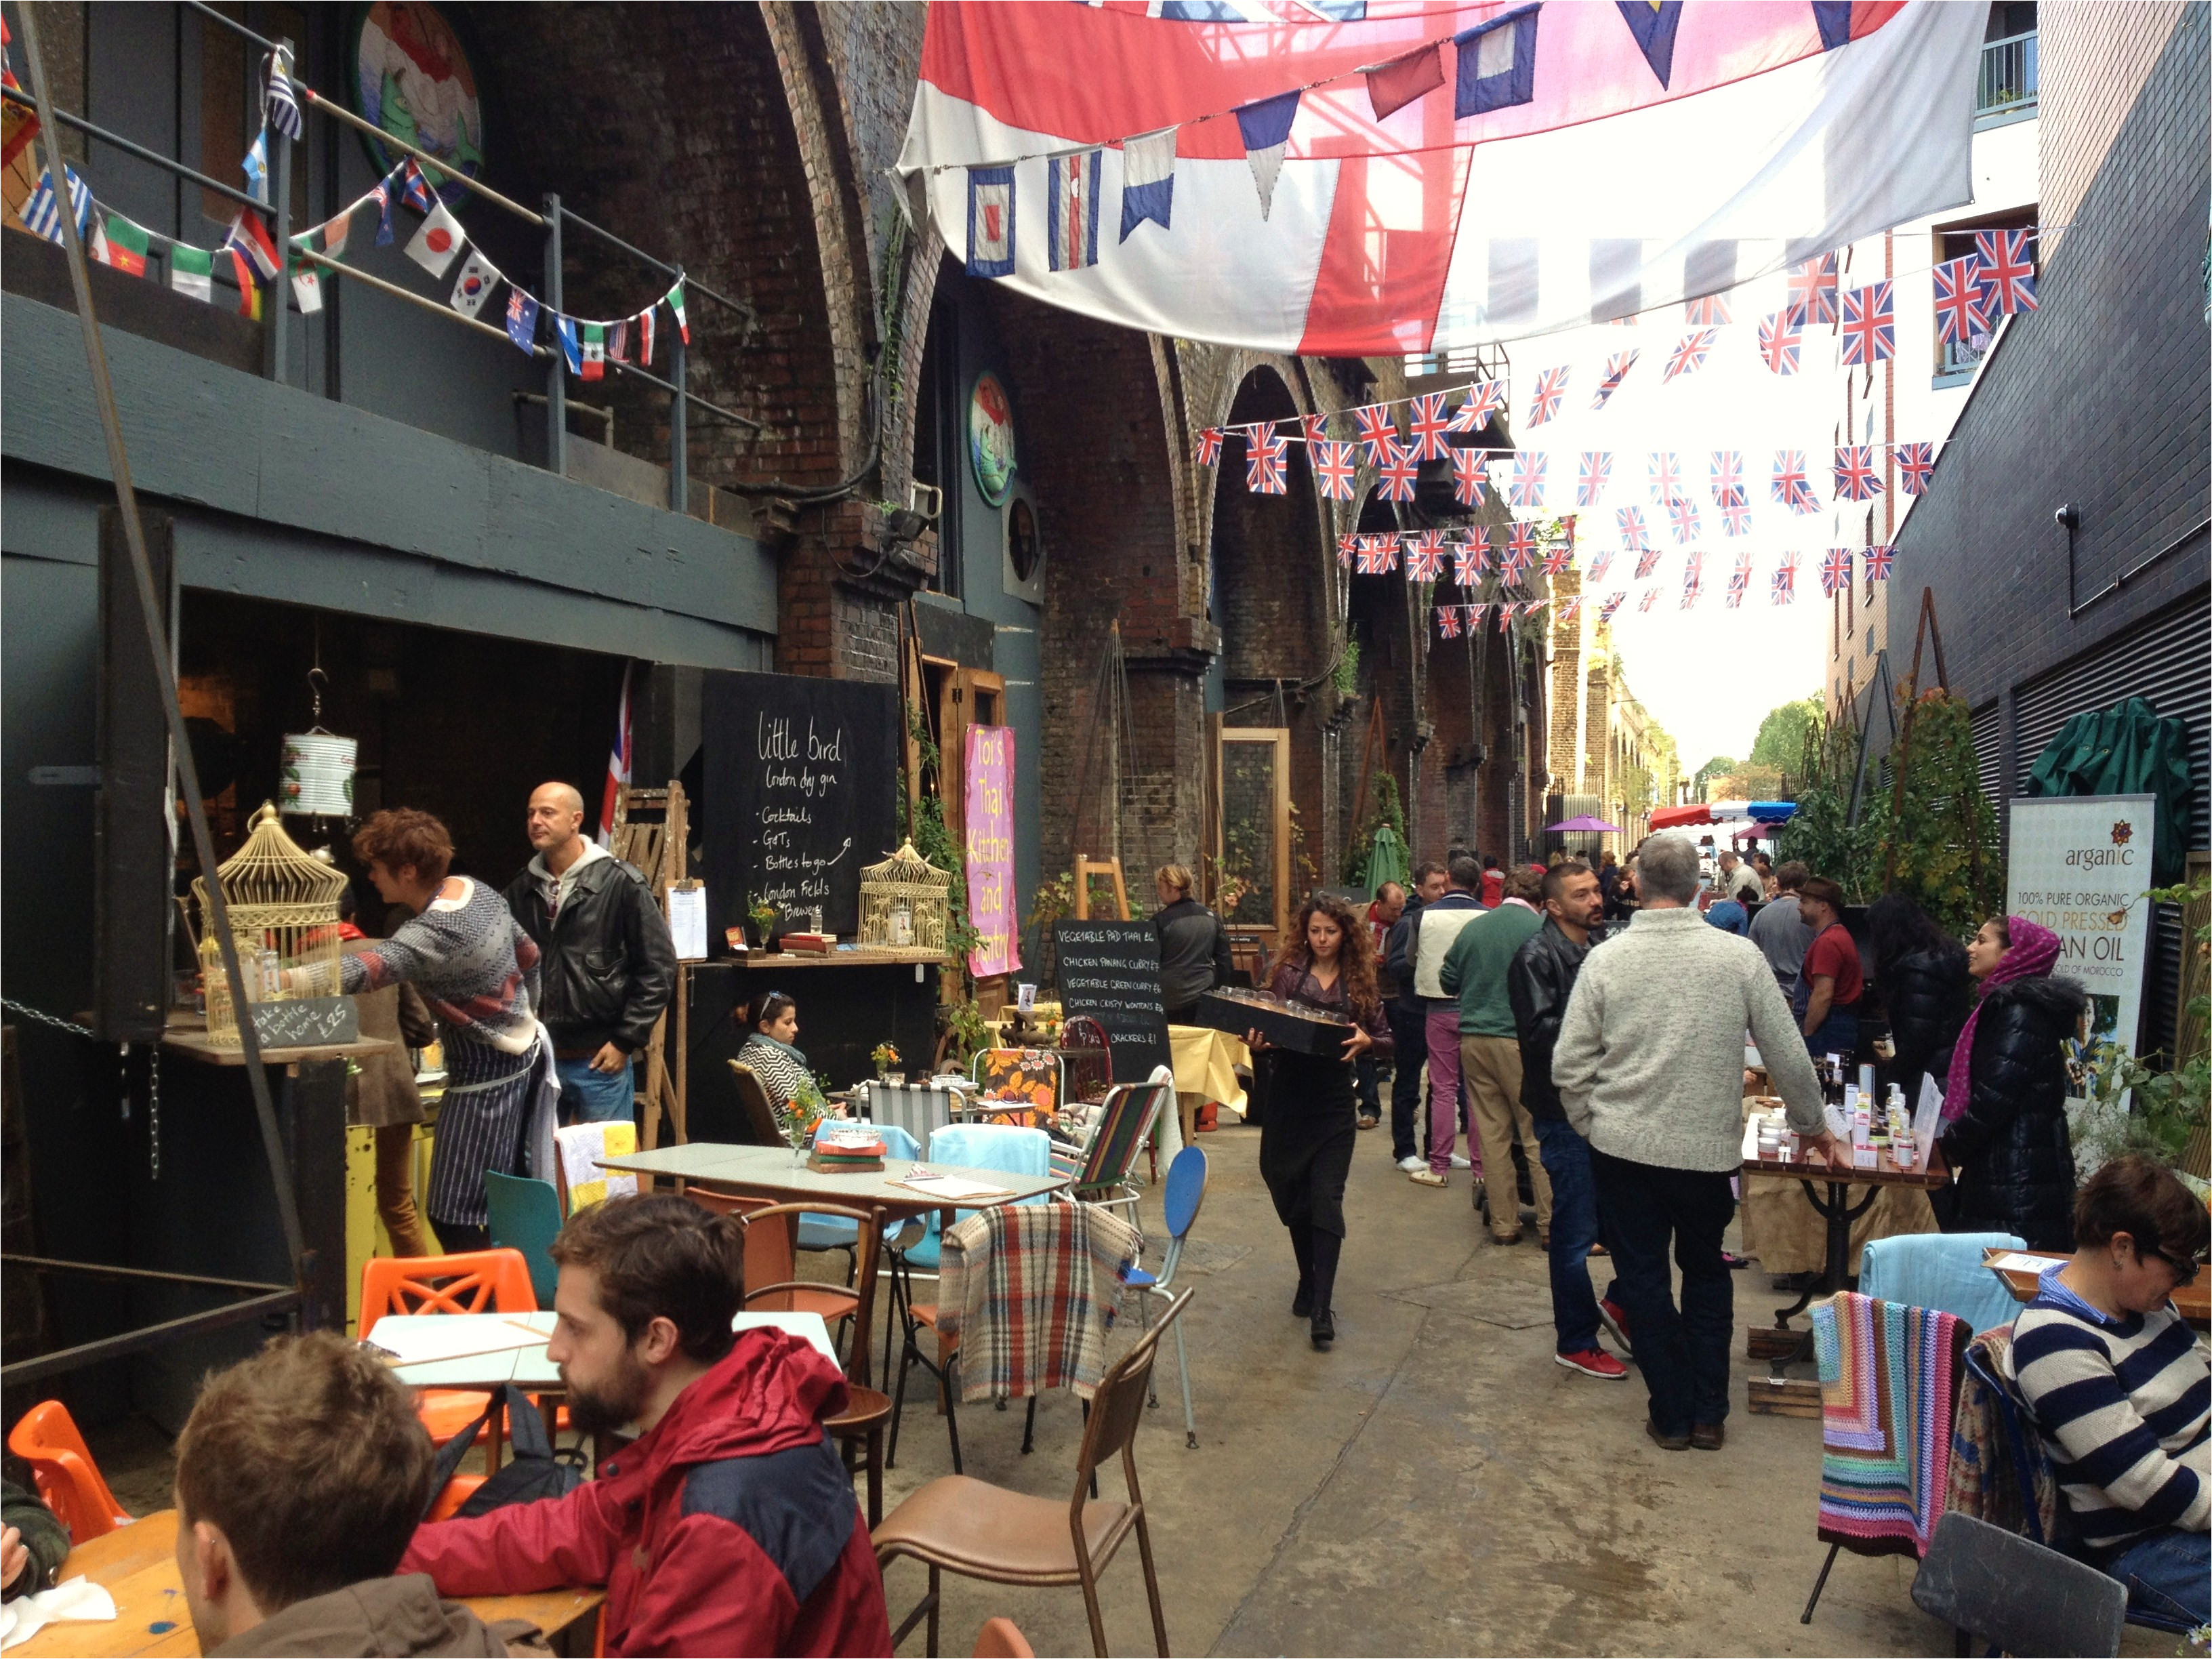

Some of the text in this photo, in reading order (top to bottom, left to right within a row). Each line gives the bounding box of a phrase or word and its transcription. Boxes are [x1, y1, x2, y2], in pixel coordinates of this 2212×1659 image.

[807, 716, 842, 761] bird
[975, 729, 1003, 766] Toi's
[800, 766, 815, 797] dry
[819, 774, 838, 797] gin
[978, 771, 1002, 818] Thai
[762, 806, 812, 824] Cocktails
[967, 819, 1010, 864] Kitchen
[765, 852, 826, 876] Bottles to go
[2066, 848, 2135, 871] arganic
[801, 878, 830, 898] Fields
[981, 871, 1002, 916] and
[2018, 892, 2129, 907] 100% PURE ORGANIC
[1058, 930, 1105, 943] VEGETABLE
[1106, 929, 1122, 943] PAD
[1122, 931, 1142, 943] THAI
[2093, 936, 2125, 961] OIL
[1063, 956, 1099, 968] CHICKEN
[1128, 958, 1151, 971] CURRY
[2071, 965, 2082, 974] OF
[2083, 966, 2123, 977] MOROCCO
[1066, 977, 1108, 989] VEGETABLE
[1110, 979, 1132, 990] GREEN
[1132, 982, 1152, 993] CURRY
[1069, 998, 1097, 1008] CHICKEN
[1099, 999, 1123, 1010] CRISPY
[1124, 1000, 1153, 1010] WONTONS
[251, 1006, 281, 1029] take
[260, 1005, 308, 1043] a bottle
[285, 1010, 323, 1041] home
[1111, 1033, 1147, 1044] CRACKERS
[1148, 1033, 1157, 1044] £1
